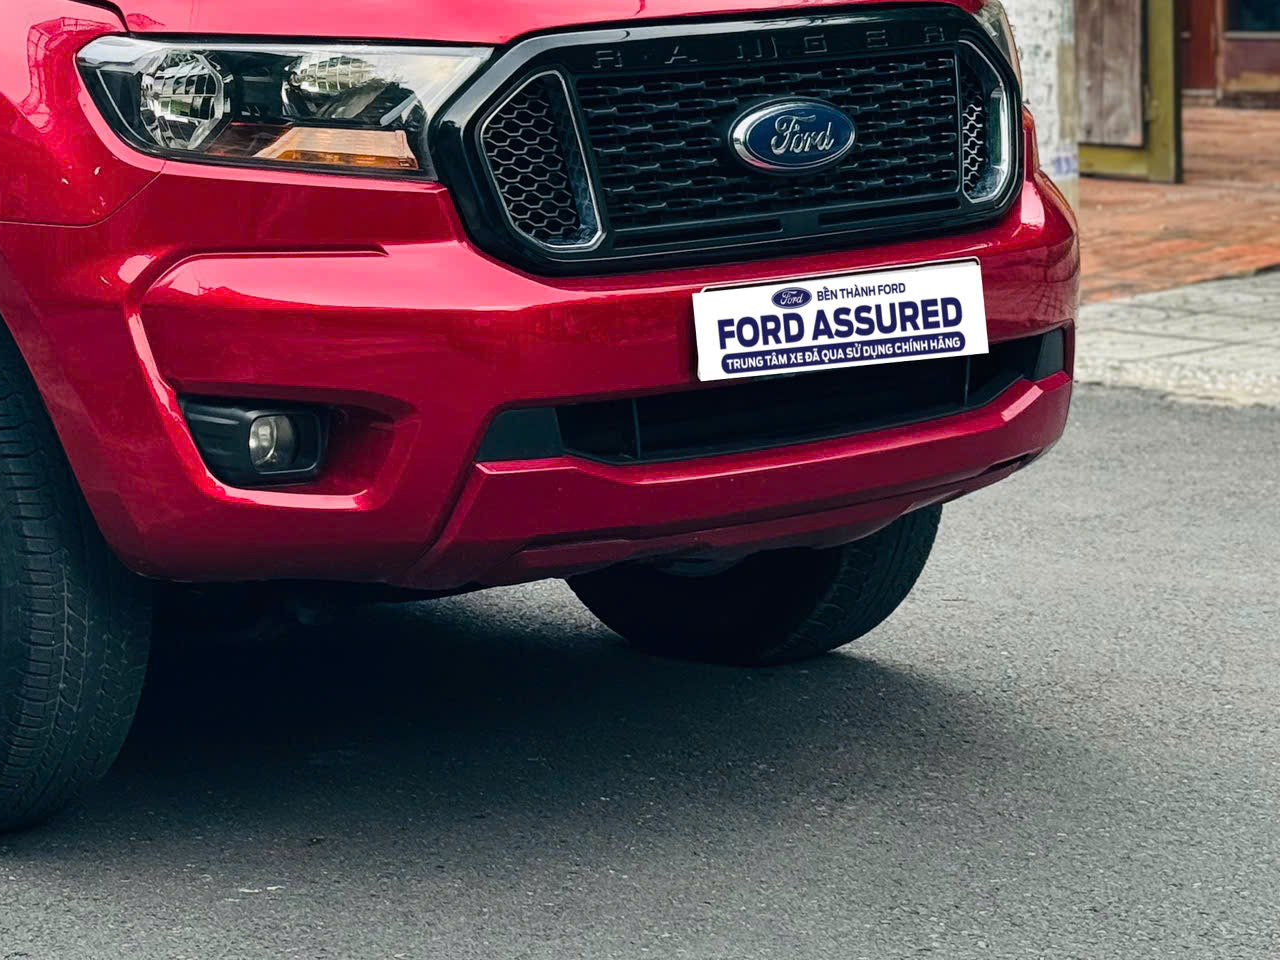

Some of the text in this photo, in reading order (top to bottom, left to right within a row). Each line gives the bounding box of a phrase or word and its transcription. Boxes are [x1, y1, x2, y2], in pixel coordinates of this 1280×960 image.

[770, 114, 835, 156] Ford
[780, 289, 804, 305] Ford
[839, 284, 876, 299] THÀNH
[877, 283, 906, 295] FORD
[717, 296, 963, 349] FORD ASSURED
[726, 356, 764, 370] TRUNG
[764, 352, 788, 366] TÂM
[789, 352, 804, 364] XE
[805, 348, 820, 362] ĐÃ
[821, 348, 845, 363] QUA
[846, 343, 861, 358] SỬ
[863, 344, 893, 359] DỤNG
[894, 338, 928, 354] CHÍNH
